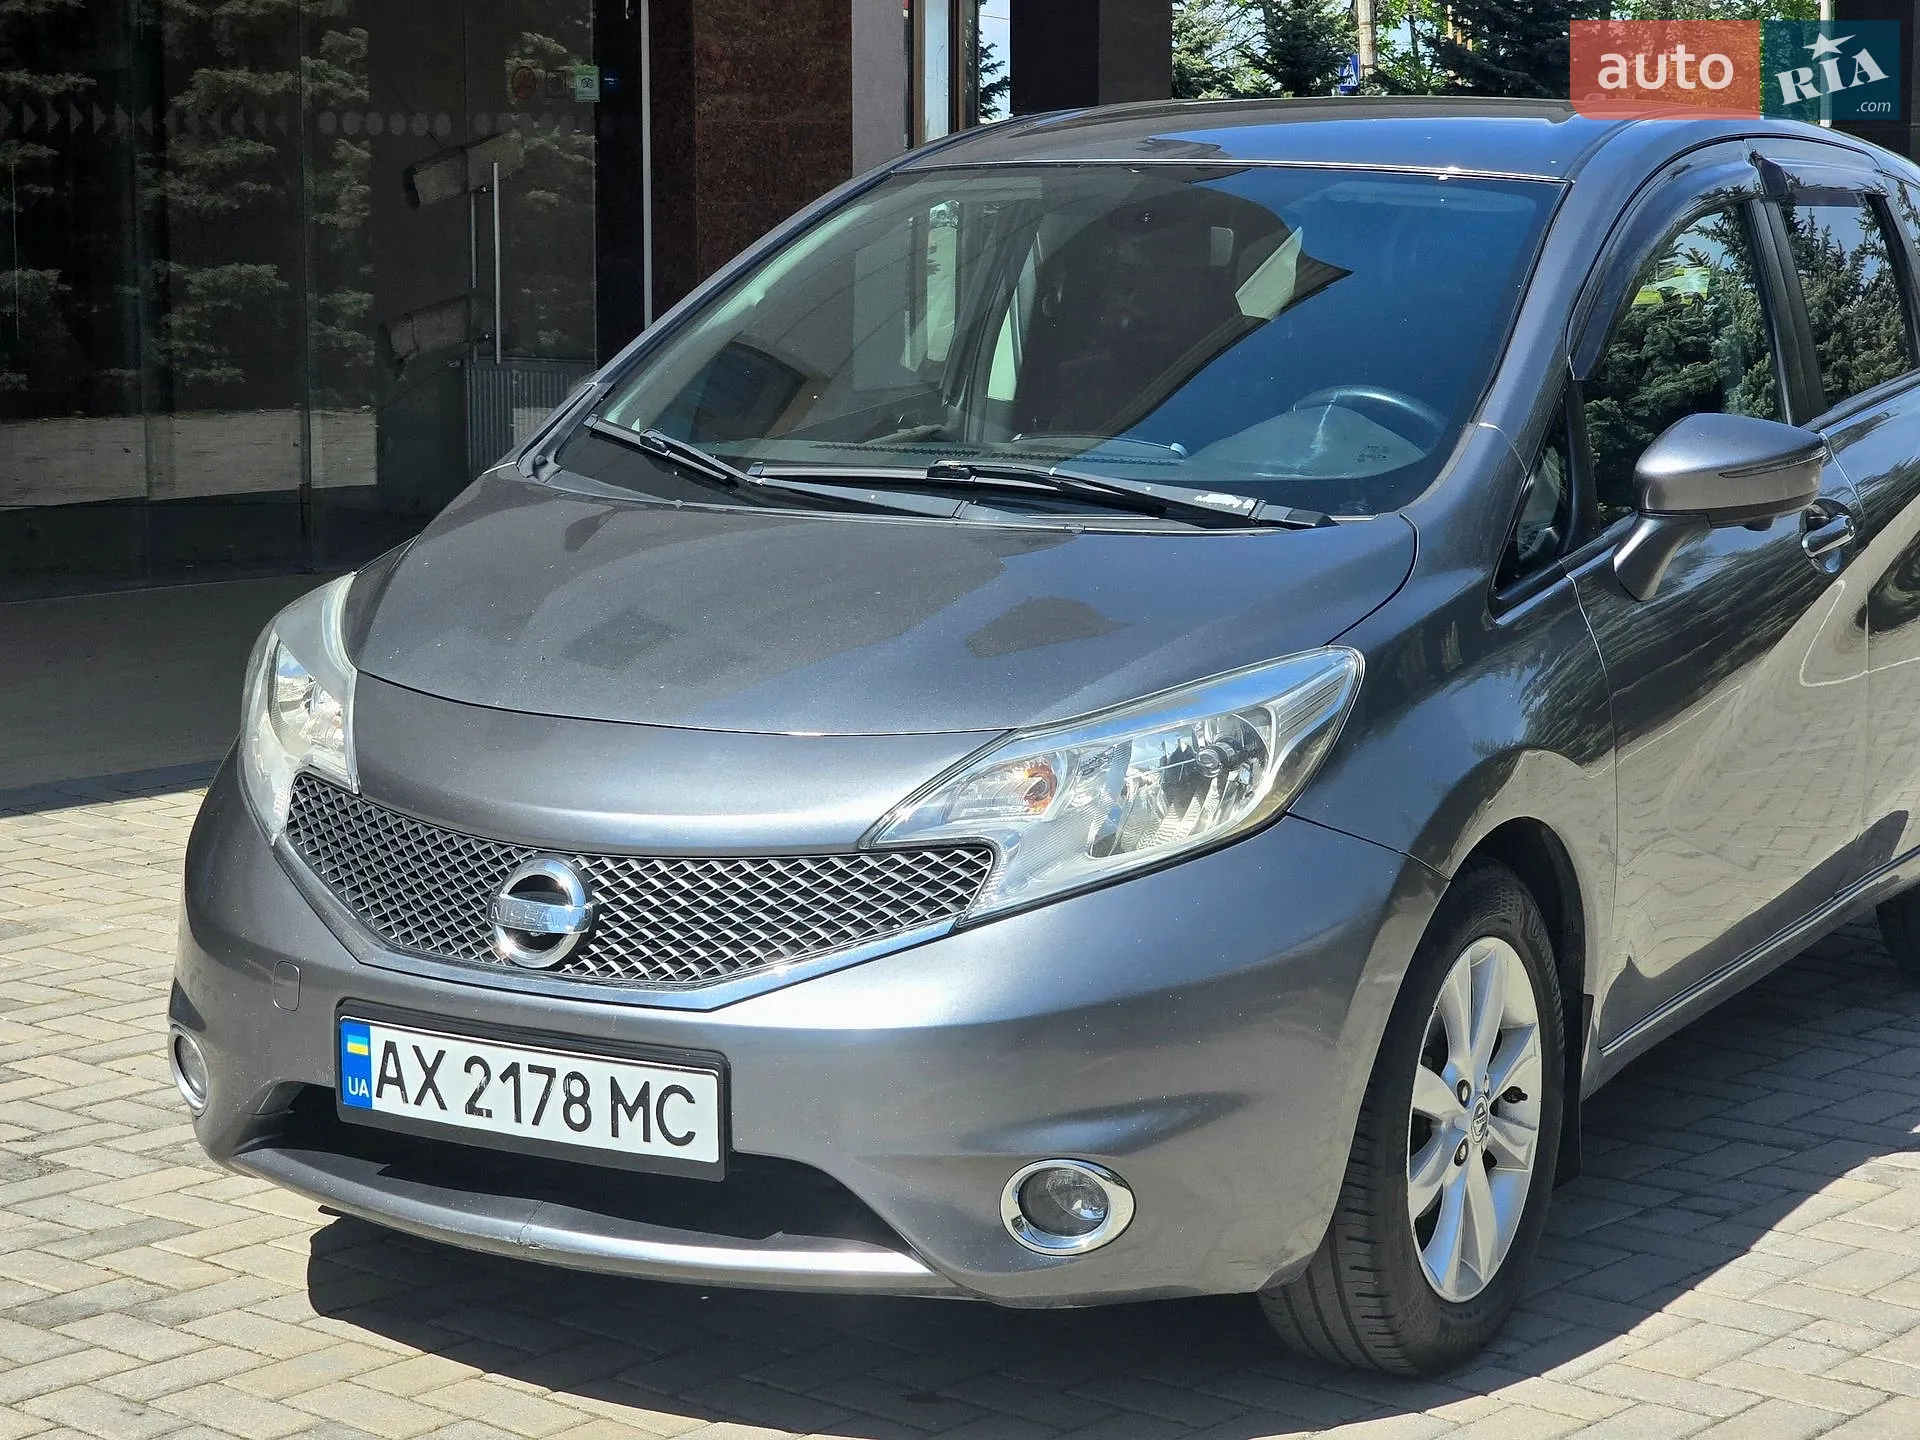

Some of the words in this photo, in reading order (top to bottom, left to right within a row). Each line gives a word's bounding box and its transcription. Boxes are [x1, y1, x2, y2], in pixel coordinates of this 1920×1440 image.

[348, 1075, 371, 1099] UA
[376, 1039, 448, 1111] AX
[463, 1054, 593, 1133] 2178
[610, 1075, 696, 1147] MC
